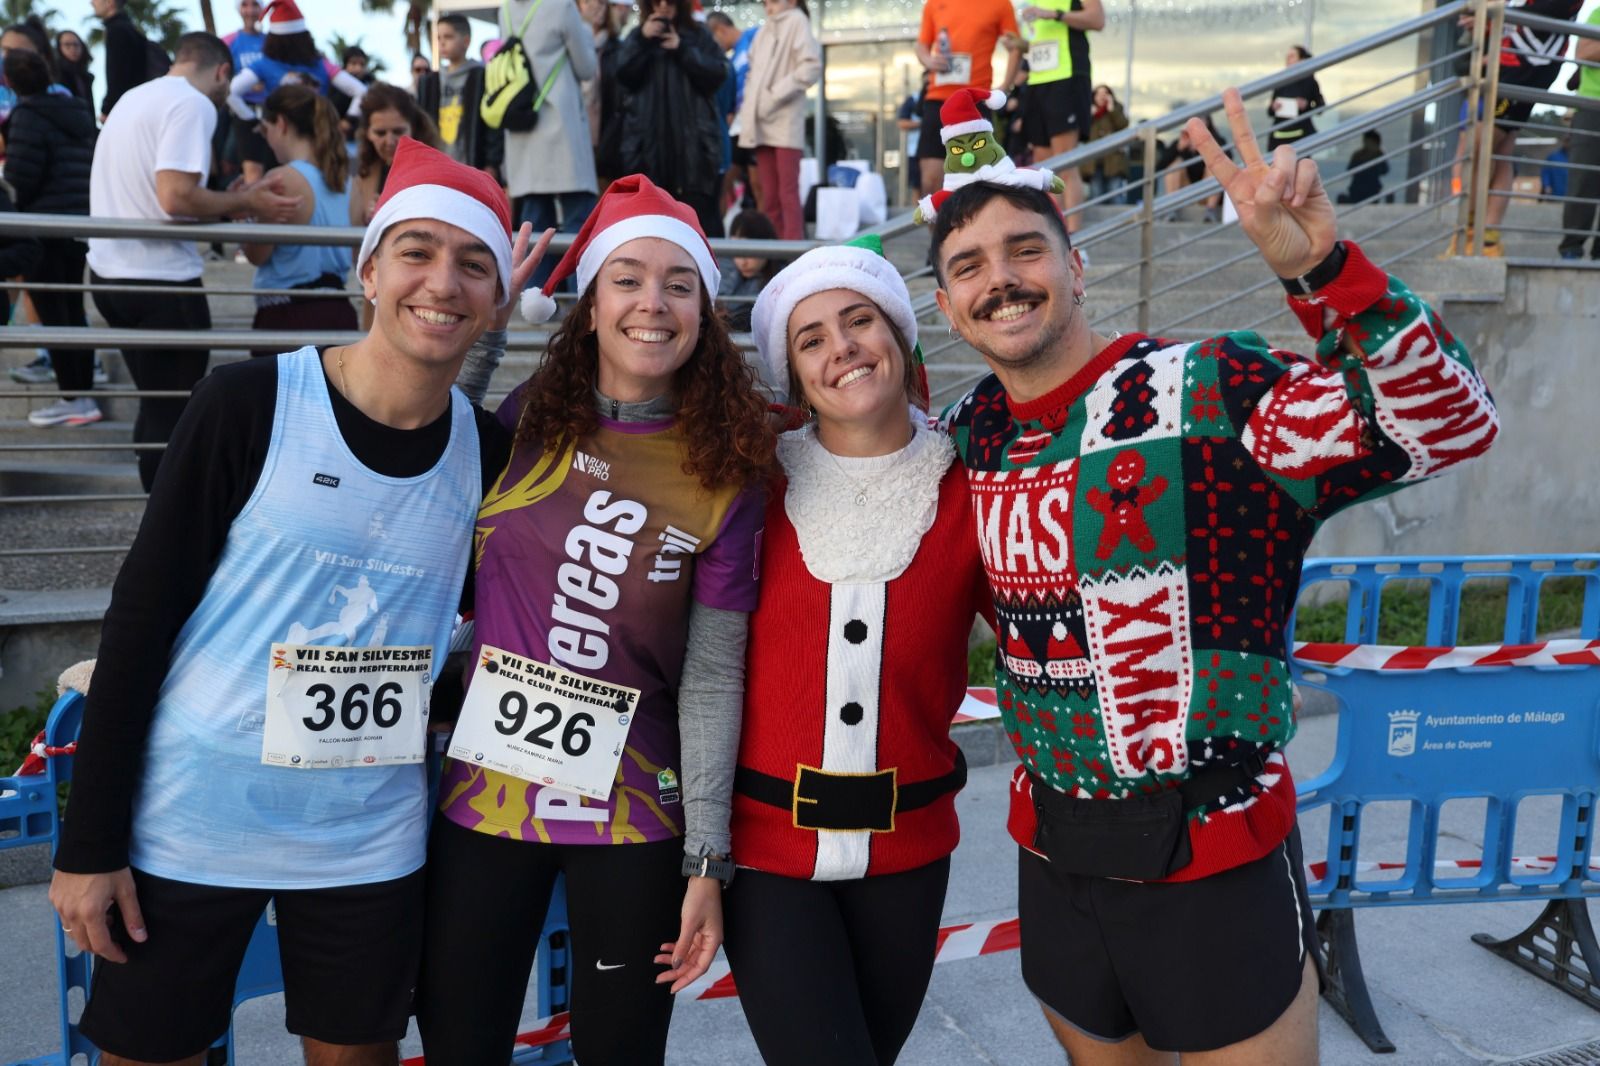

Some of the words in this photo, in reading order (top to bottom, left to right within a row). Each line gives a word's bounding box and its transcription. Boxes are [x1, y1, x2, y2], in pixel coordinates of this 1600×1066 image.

[587, 465, 610, 481] PRO
[588, 456, 611, 472] RUN
[315, 475, 339, 487] 42K
[972, 487, 1070, 573] MAS
[315, 550, 338, 564] VII
[340, 555, 363, 568] San
[366, 558, 425, 577] Silvestre
[647, 525, 701, 582] trail
[296, 649, 320, 661] VII
[325, 650, 359, 662] SAN
[362, 649, 432, 662] SILVESTRE
[296, 664, 327, 673] REAL
[330, 664, 357, 674] CLUB
[499, 669, 524, 683] REAL
[527, 675, 553, 692] CLUB
[553, 687, 619, 710] MEDITERRAN
[501, 654, 522, 670] VII
[525, 662, 557, 682] SAN
[559, 675, 637, 703] SILVESTRE
[1098, 587, 1180, 773] XMAS
[302, 681, 404, 732] 366
[1425, 714, 1504, 728] Ayuntamiento
[1507, 713, 1521, 723] de
[1524, 711, 1565, 724] Málaga
[494, 690, 596, 757] 926
[1423, 739, 1443, 750] Área
[1445, 740, 1456, 749] de
[1458, 740, 1492, 751] Deporte
